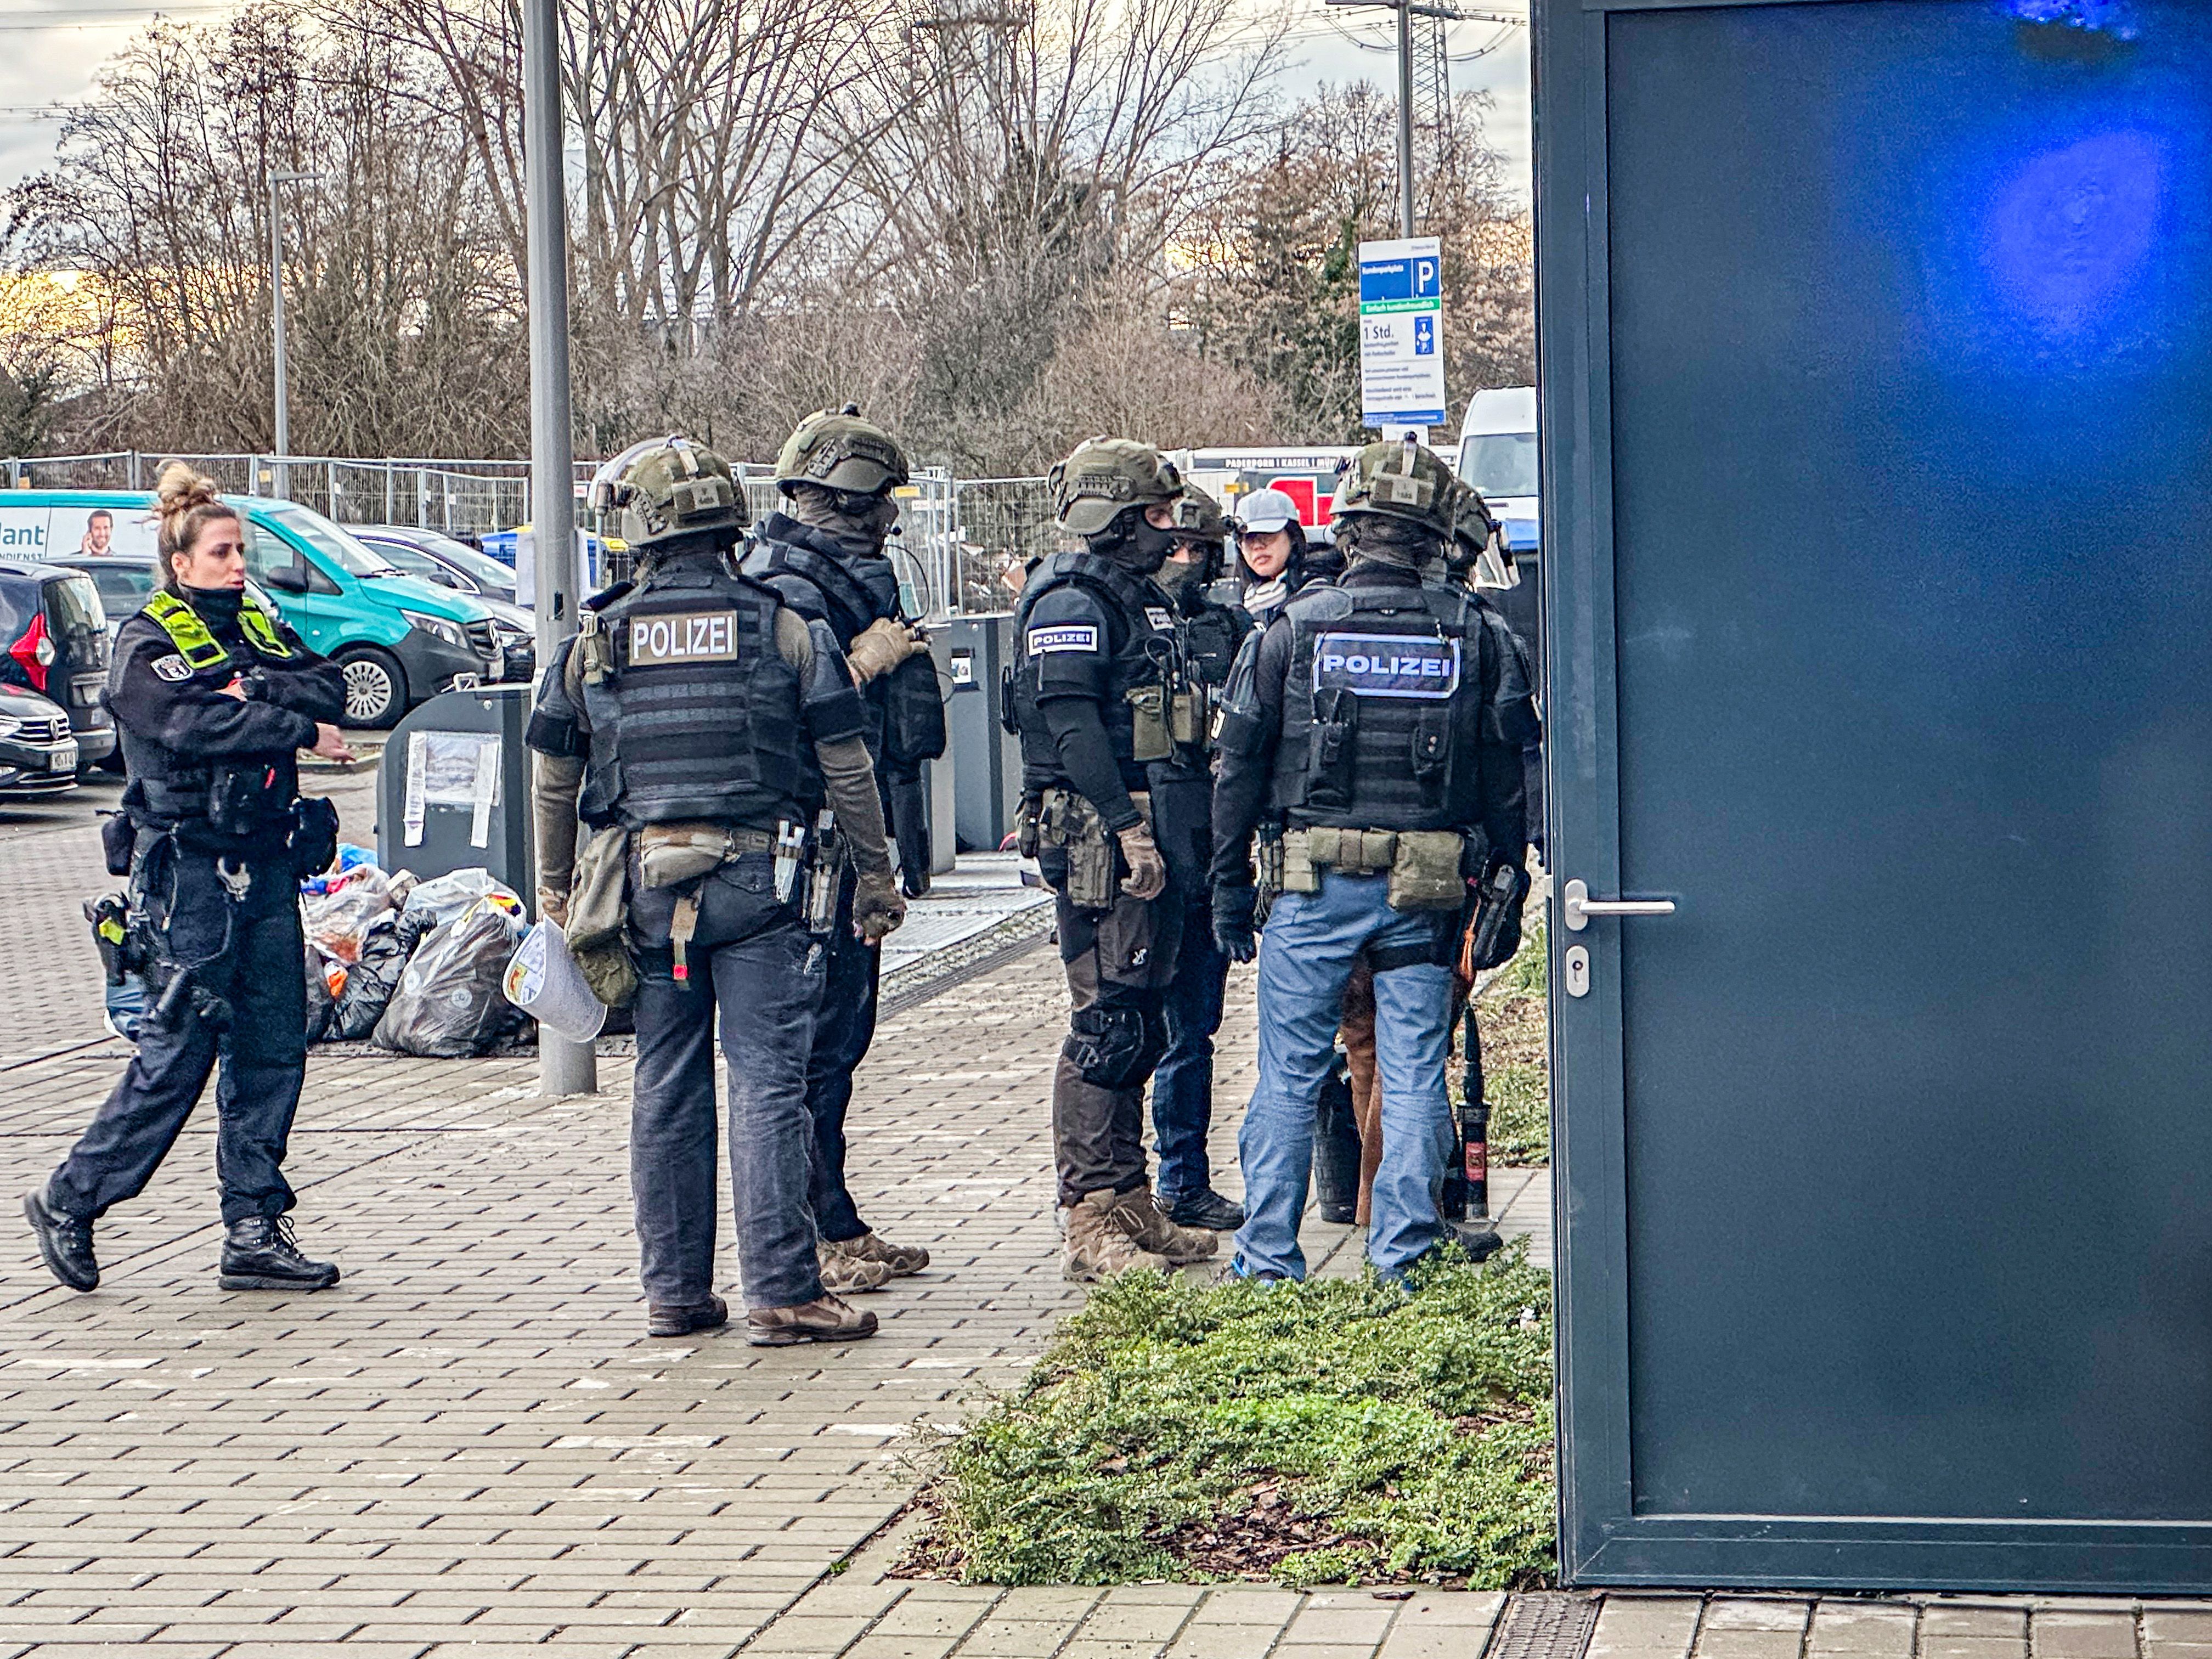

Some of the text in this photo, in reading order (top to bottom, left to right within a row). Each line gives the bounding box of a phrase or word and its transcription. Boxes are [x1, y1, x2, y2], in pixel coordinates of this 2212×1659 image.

[1418, 261, 1434, 294] P
[1364, 324, 1393, 340] 1 Std.
[1281, 458, 1310, 467] KASSEL
[634, 616, 732, 659] POLIZEI
[1034, 634, 1090, 646] POLIZEI
[1323, 655, 1450, 677] POLIZEI
